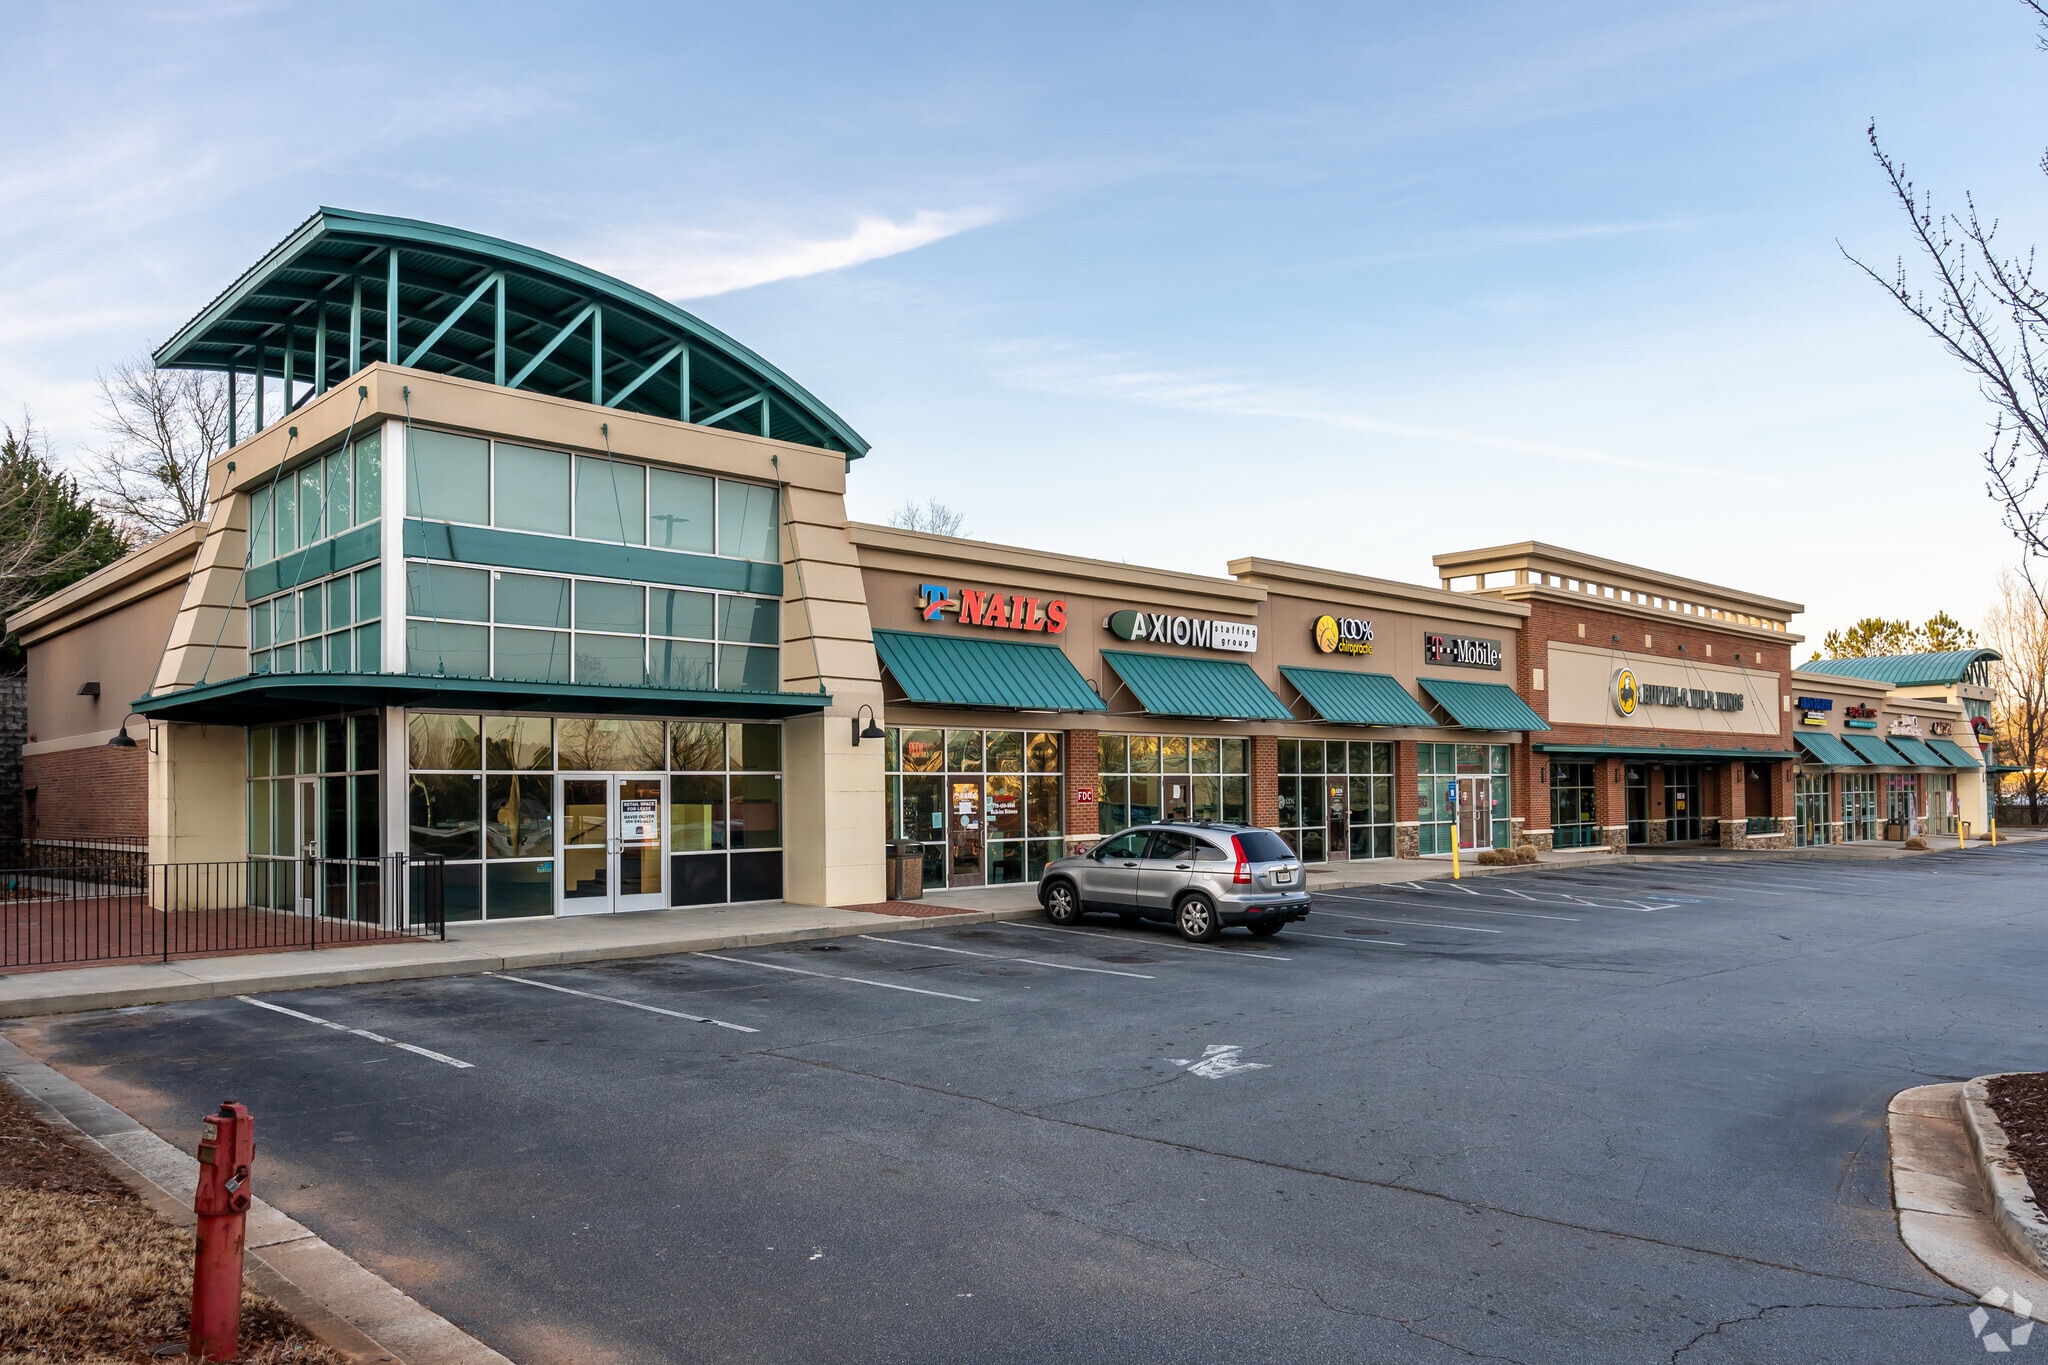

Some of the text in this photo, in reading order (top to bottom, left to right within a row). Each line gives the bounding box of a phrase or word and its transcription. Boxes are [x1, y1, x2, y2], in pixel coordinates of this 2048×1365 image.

[958, 589, 1067, 634] NAILS
[1130, 612, 1212, 648] AXIOM
[1214, 624, 1256, 638] staffing
[1339, 617, 1374, 641] 100%
[1221, 637, 1249, 649] group
[1338, 638, 1373, 657] chiropractic
[1642, 683, 1688, 708] BUFFALO
[1078, 791, 1092, 801] FDC
